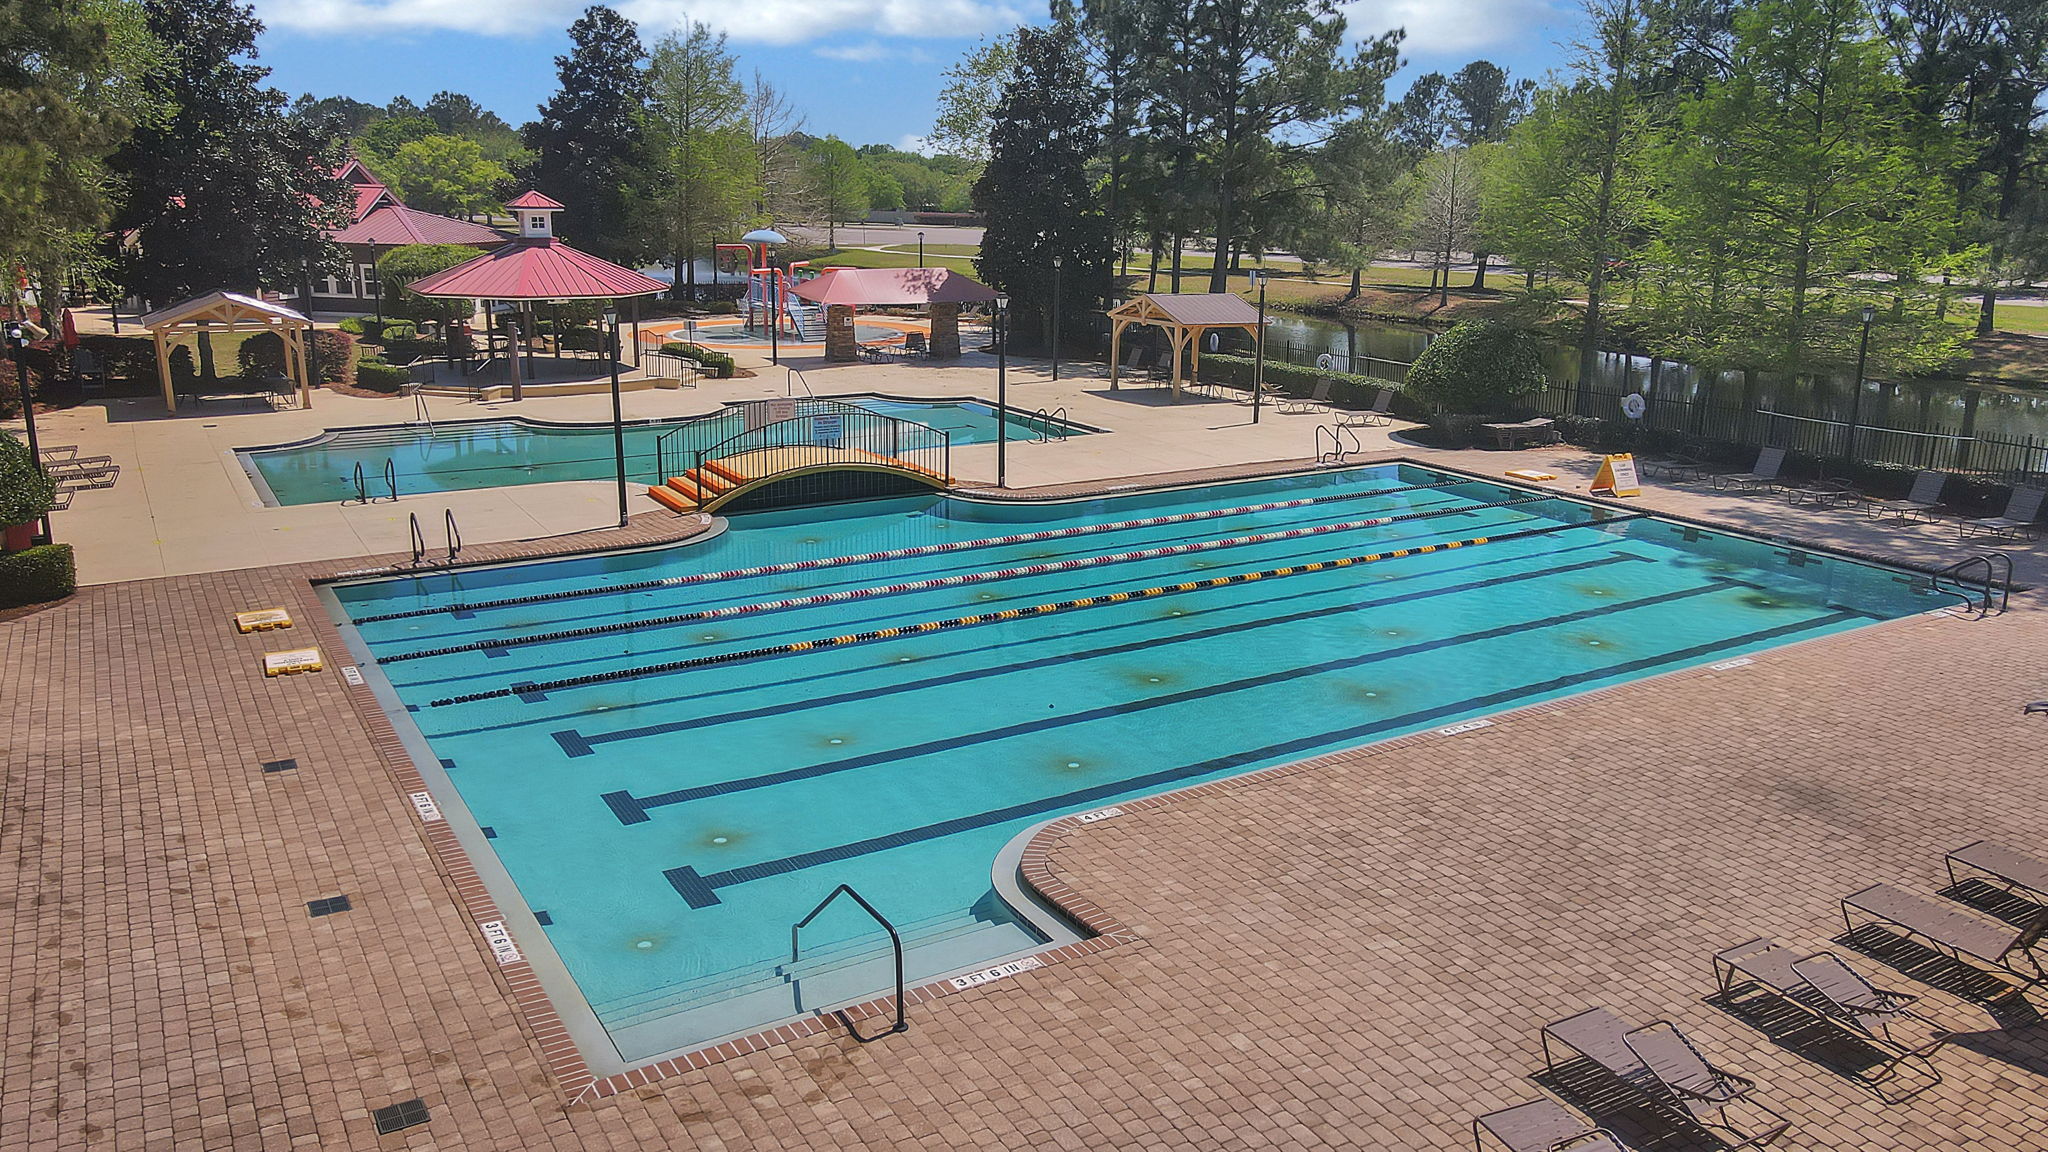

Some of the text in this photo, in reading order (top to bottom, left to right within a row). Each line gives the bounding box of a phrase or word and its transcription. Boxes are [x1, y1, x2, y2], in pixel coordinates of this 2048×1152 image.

[488, 929, 504, 938] FT
[496, 945, 512, 954] IN
[956, 978, 968, 986] 3
[969, 973, 986, 982] FT
[989, 969, 1001, 977] 6
[1003, 964, 1020, 974] IN
